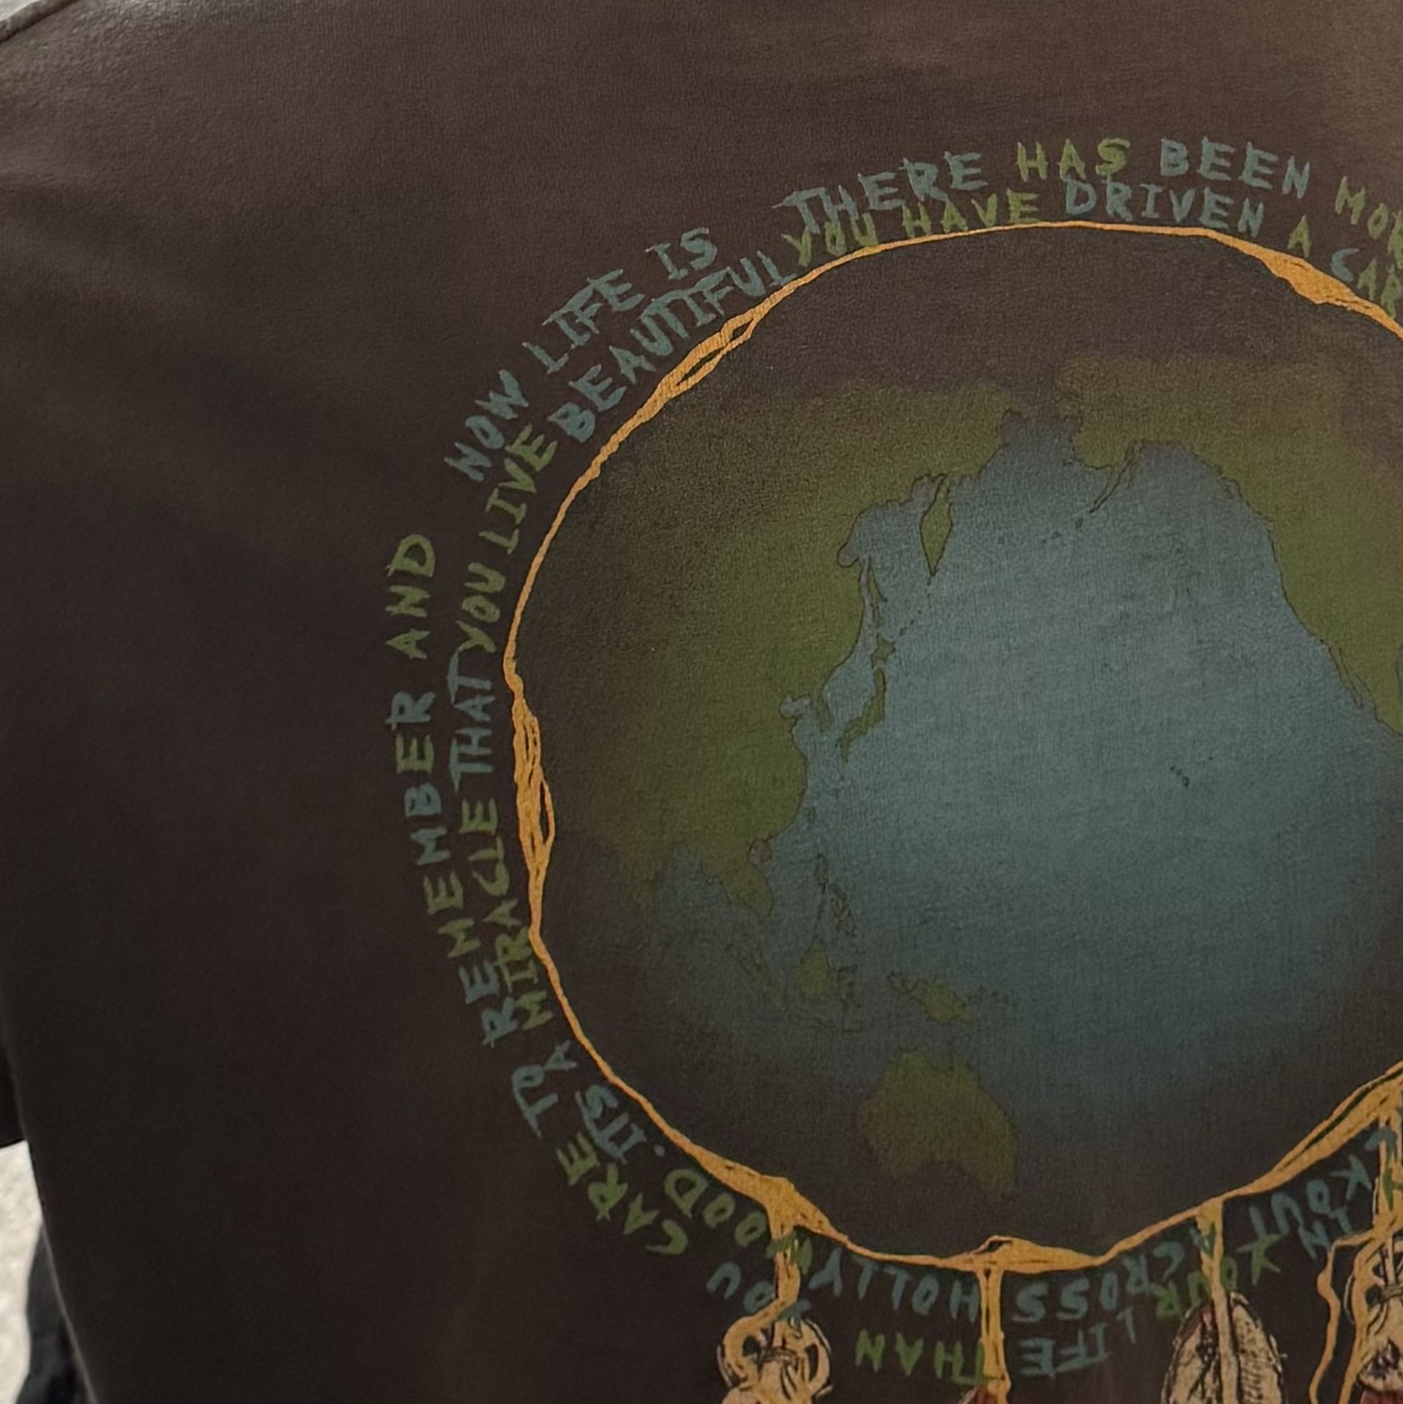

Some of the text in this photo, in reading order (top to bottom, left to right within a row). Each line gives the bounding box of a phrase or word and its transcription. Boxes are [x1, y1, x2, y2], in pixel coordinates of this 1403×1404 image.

[771, 150, 989, 234] THERE
[1016, 136, 1132, 183] HAS
[1159, 135, 1311, 199] BEEN
[780, 211, 880, 267] YOU
[901, 187, 1040, 239] HAVE
[1063, 173, 1264, 239] DRIVEN
[1286, 213, 1313, 258] A
[644, 227, 719, 281] IS
[521, 267, 646, 375] LIFE
[547, 249, 798, 444] BEAUTIFUL
[443, 368, 529, 484] NOW
[478, 422, 558, 555] LIVE
[384, 533, 437, 660] AND
[455, 562, 506, 653] YOU
[448, 647, 495, 794] THAT
[384, 689, 520, 1049] REMEMBER
[458, 797, 555, 1032] MIRACLE
[544, 1039, 579, 1072] A
[511, 1063, 559, 1140] TO
[554, 1131, 689, 1256] CARE
[854, 1328, 988, 1388] THAN
[1014, 1308, 1138, 1379] LIFE
